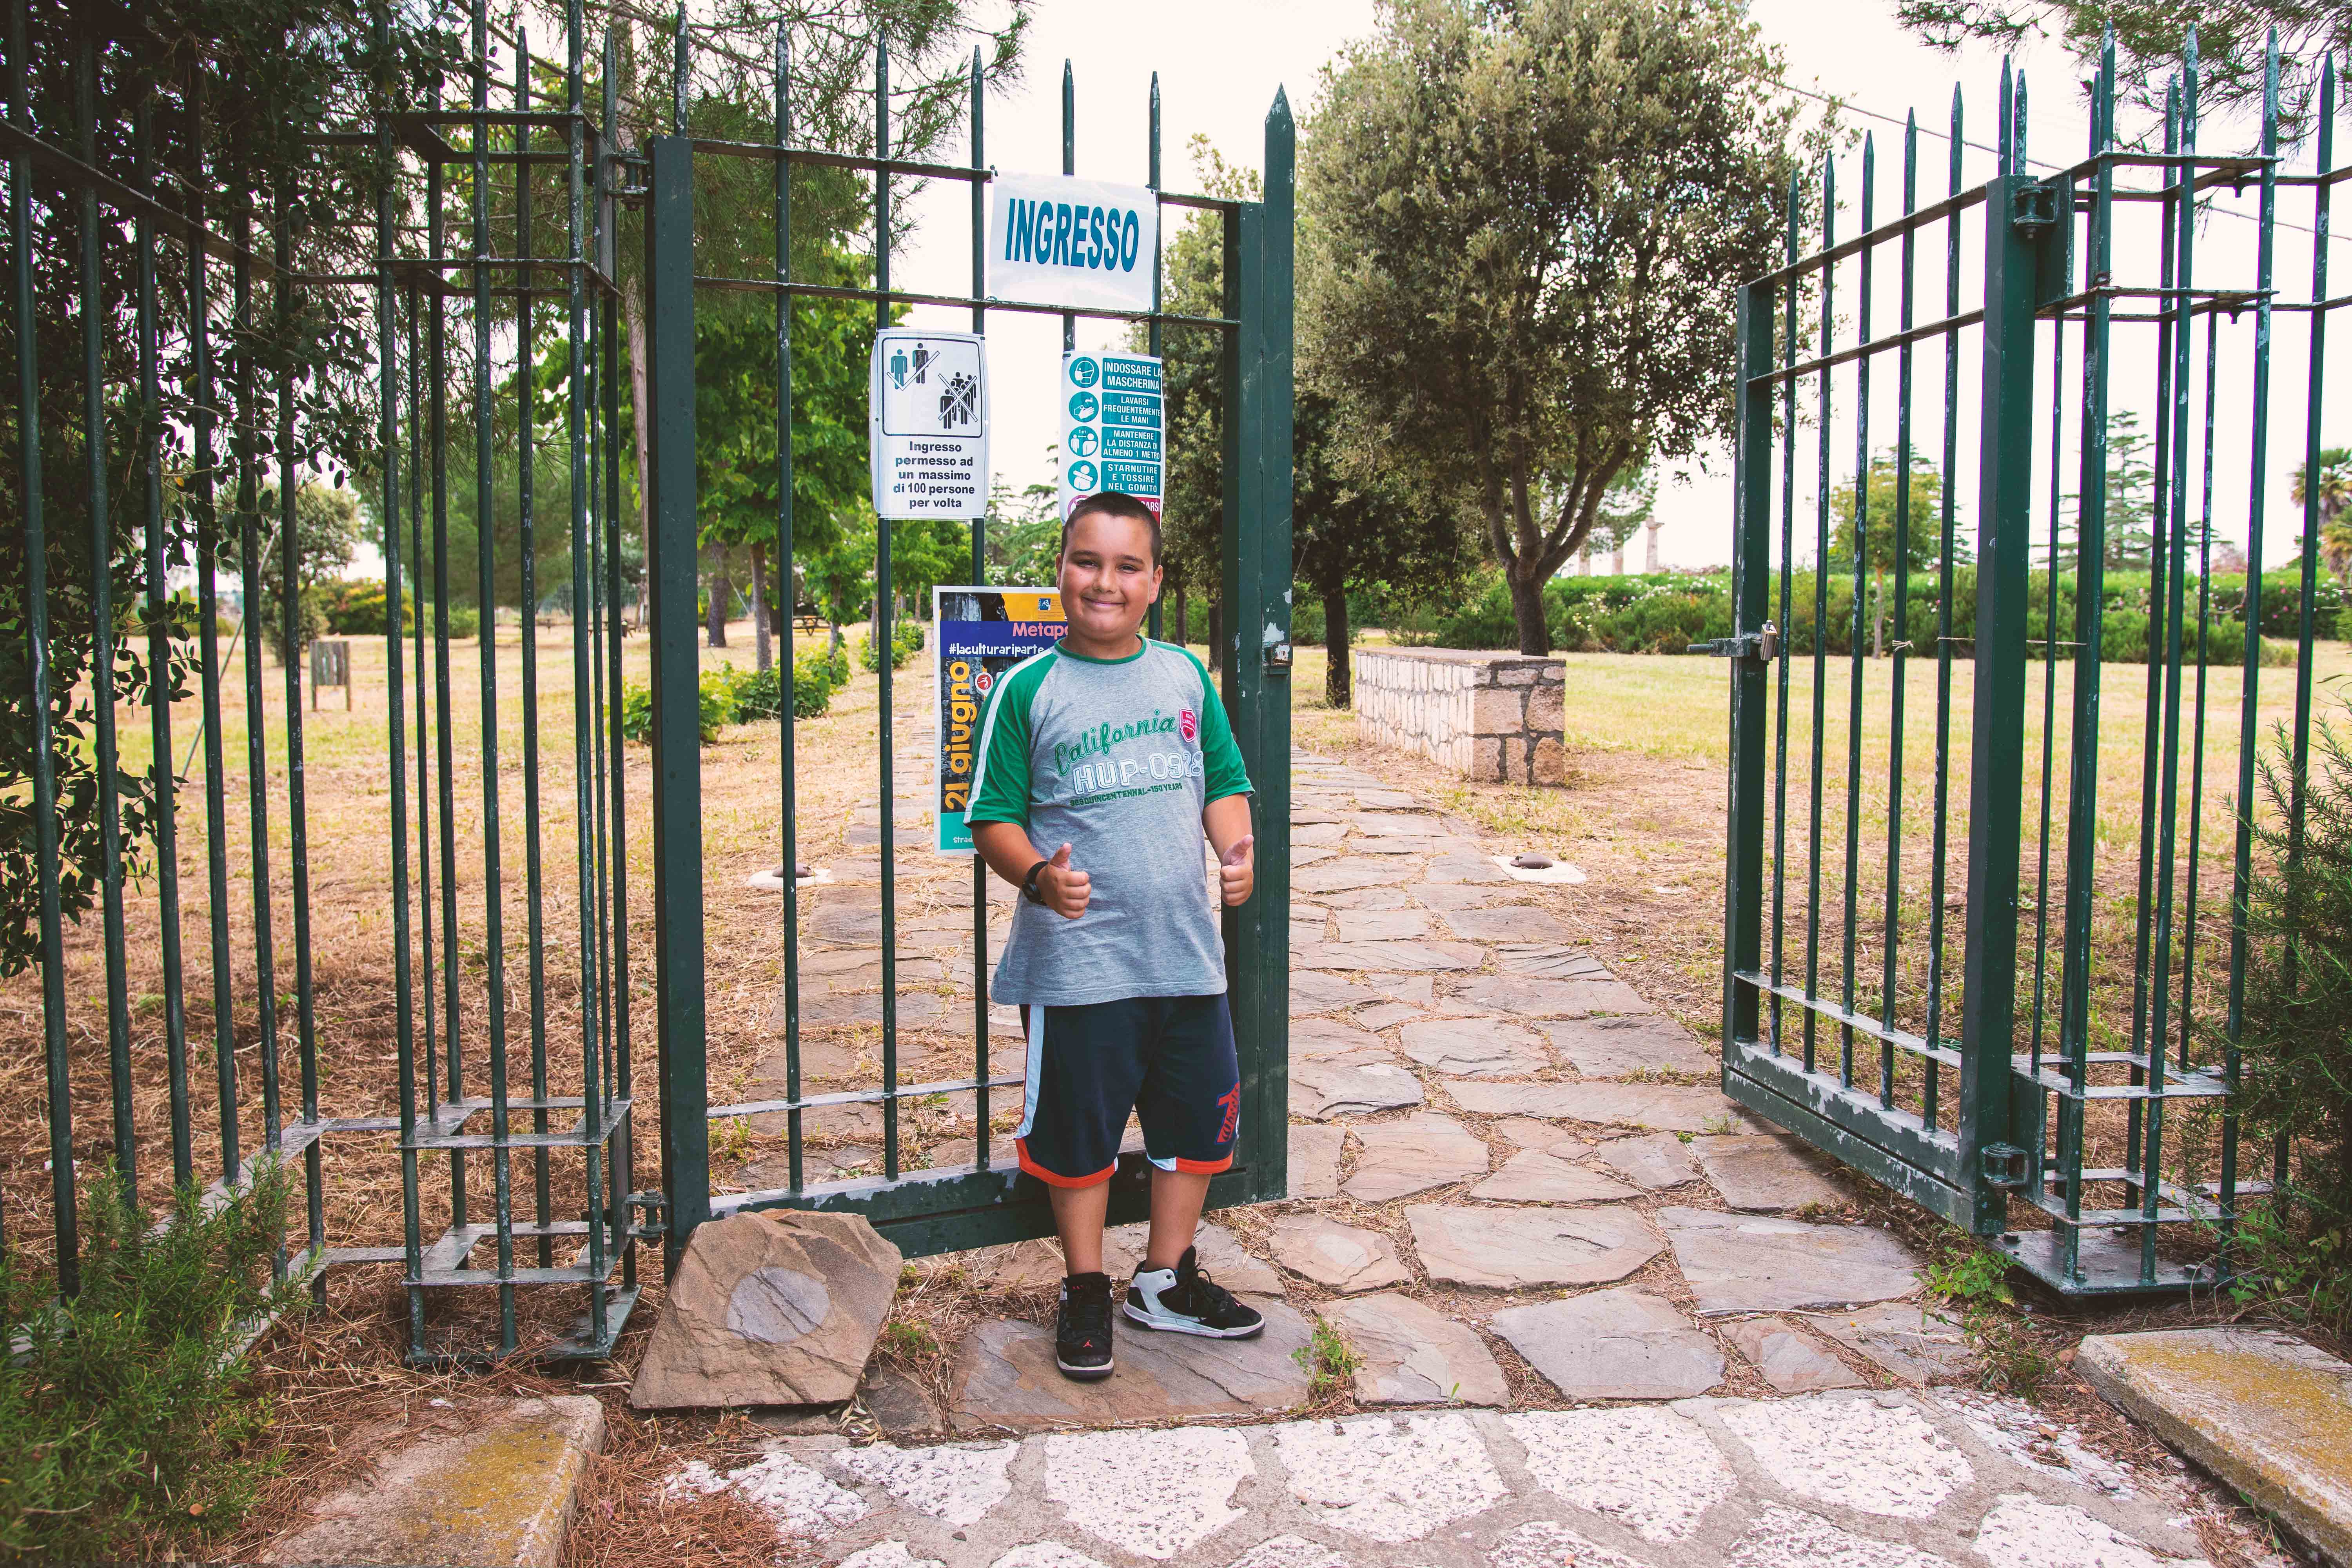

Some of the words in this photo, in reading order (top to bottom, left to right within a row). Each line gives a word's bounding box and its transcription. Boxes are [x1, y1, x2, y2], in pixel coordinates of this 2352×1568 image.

[1005, 198, 1139, 272] INGRESSO
[1104, 362, 1151, 376] INDOSSARE
[1153, 367, 1161, 378] LA
[1107, 375, 1160, 390] MASCHERINA
[1121, 396, 1149, 406] LAVARSI
[1103, 404, 1160, 417] FREQUENTEMENTE
[1132, 416, 1149, 425] MANI
[1114, 430, 1154, 440] MANTENERE
[909, 441, 962, 454] Ingresso
[1107, 439, 1117, 447] LA
[1119, 439, 1151, 449] DISTANZA
[1103, 448, 1133, 457] ALMENO
[1141, 451, 1160, 459] METRO
[895, 457, 956, 467] permesso
[960, 457, 973, 466] ad
[1107, 464, 1158, 474] STARNUTIRE
[918, 470, 971, 480] massimo
[1121, 474, 1154, 483] TOSSIRE
[893, 483, 905, 493] di
[908, 483, 926, 493] 100
[929, 486, 975, 496] persone
[1128, 483, 1157, 493] GOMITO
[909, 499, 930, 509] per
[933, 497, 962, 508] volta
[1141, 501, 1160, 512] ARSI
[949, 642, 1045, 657] #laculturariparte
[944, 661, 977, 774] giugno
[1054, 709, 1176, 777] California
[1163, 782, 1183, 791] YEARS
[944, 783, 970, 809] 21
